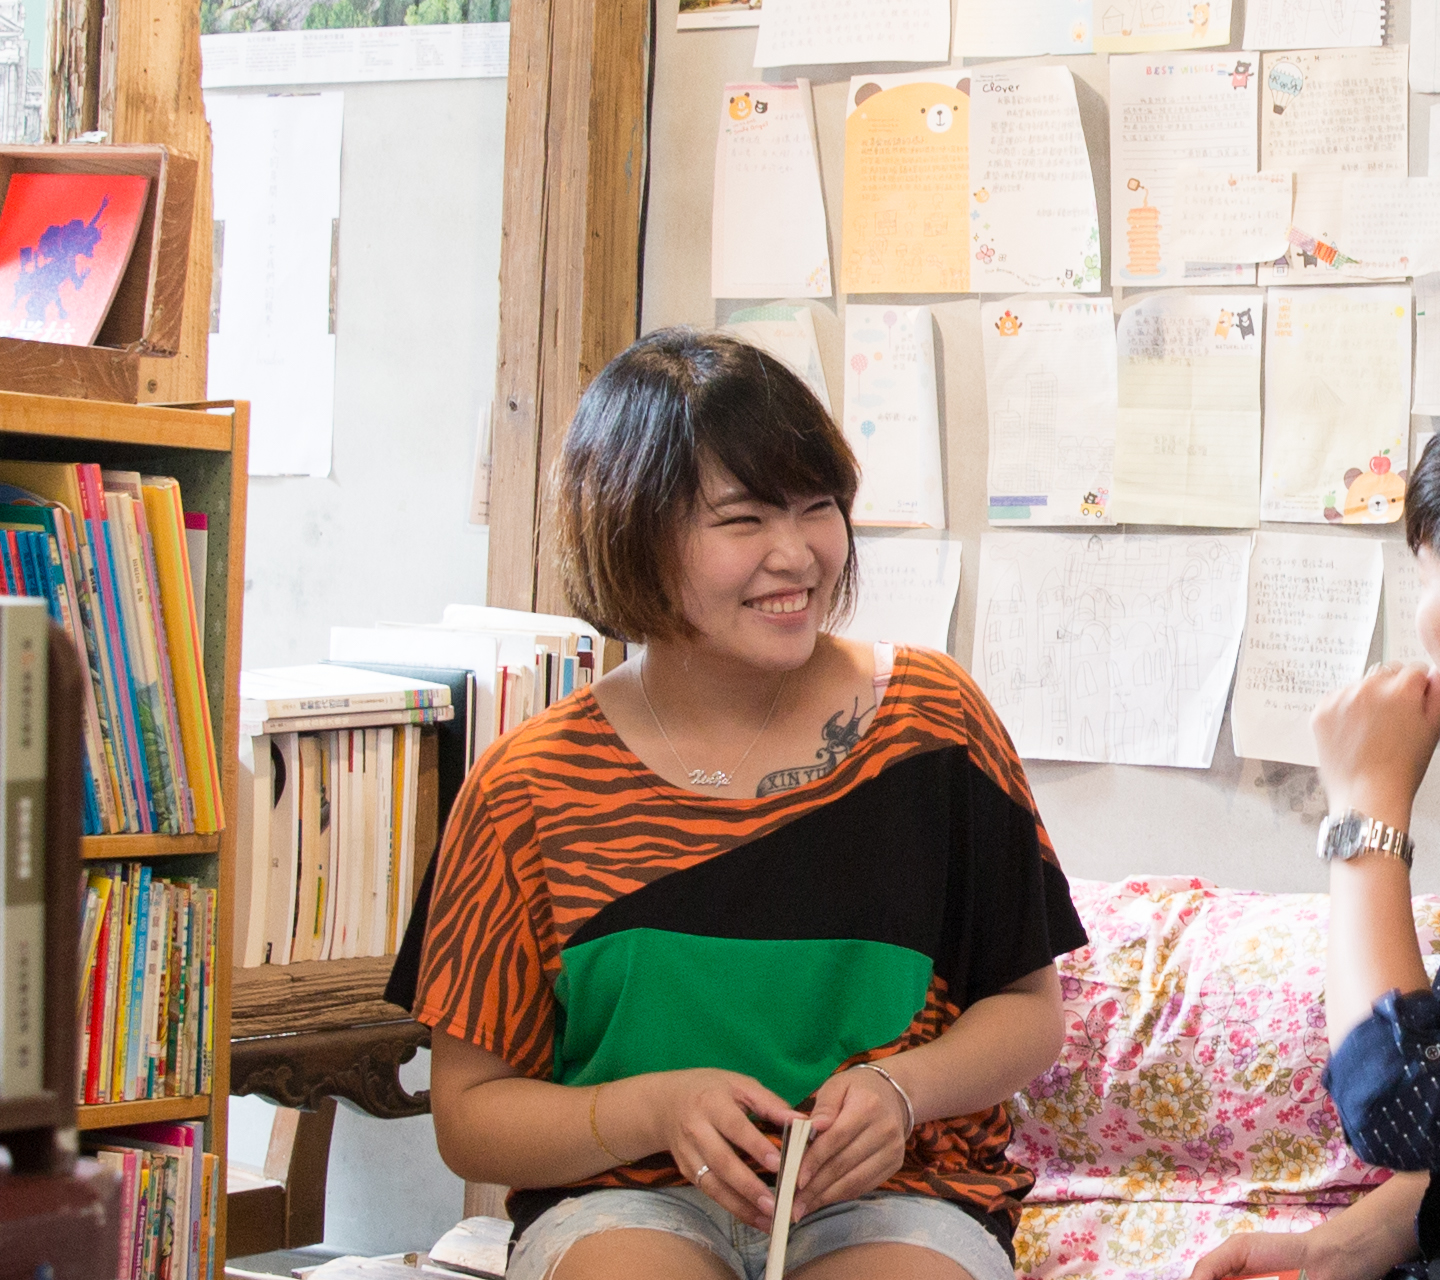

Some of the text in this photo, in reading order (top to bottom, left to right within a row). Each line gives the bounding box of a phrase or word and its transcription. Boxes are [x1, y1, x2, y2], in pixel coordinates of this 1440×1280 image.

[1145, 63, 1215, 76] BEST WISHES
[982, 81, 1021, 94] Clover
[767, 769, 799, 790] XIN
